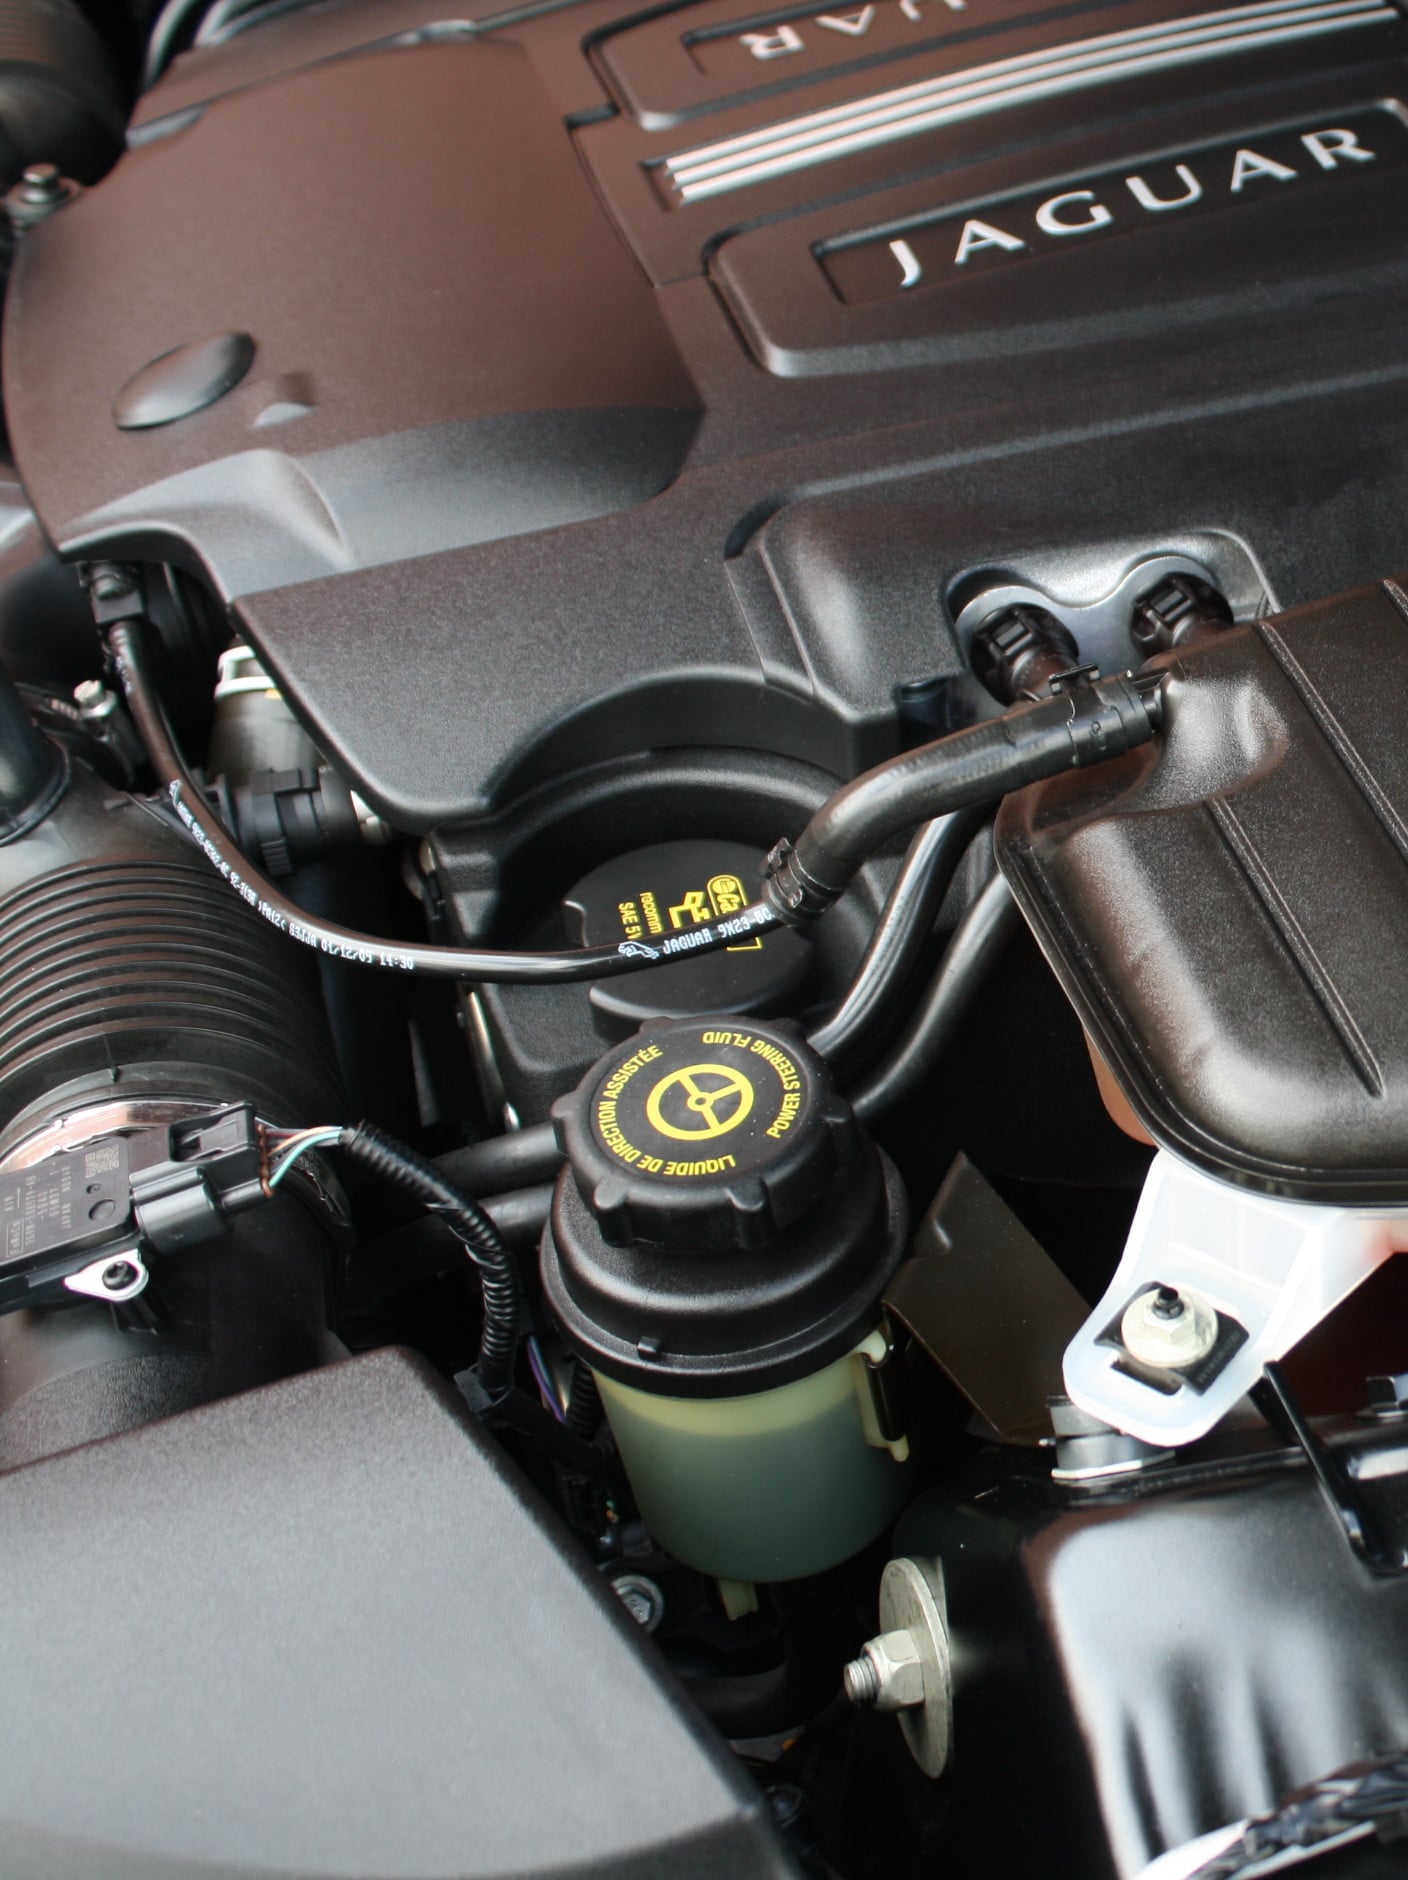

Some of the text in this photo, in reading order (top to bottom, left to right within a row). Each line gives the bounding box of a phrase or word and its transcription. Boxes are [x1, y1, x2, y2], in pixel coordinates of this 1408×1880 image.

[888, 128, 1376, 288] JAGUAR
[618, 901, 639, 925] SAE
[640, 892, 663, 934] recomm
[716, 893, 740, 914] Ca
[662, 906, 775, 955] JAGUAR 9X23-8C
[320, 941, 373, 964] 01/12/09
[379, 951, 415, 971] 14:30
[702, 1031, 802, 1139] POWER STEERING FLUID
[597, 1044, 737, 1176] LIQUIDE DE DIRECTION ASSISTÉE
